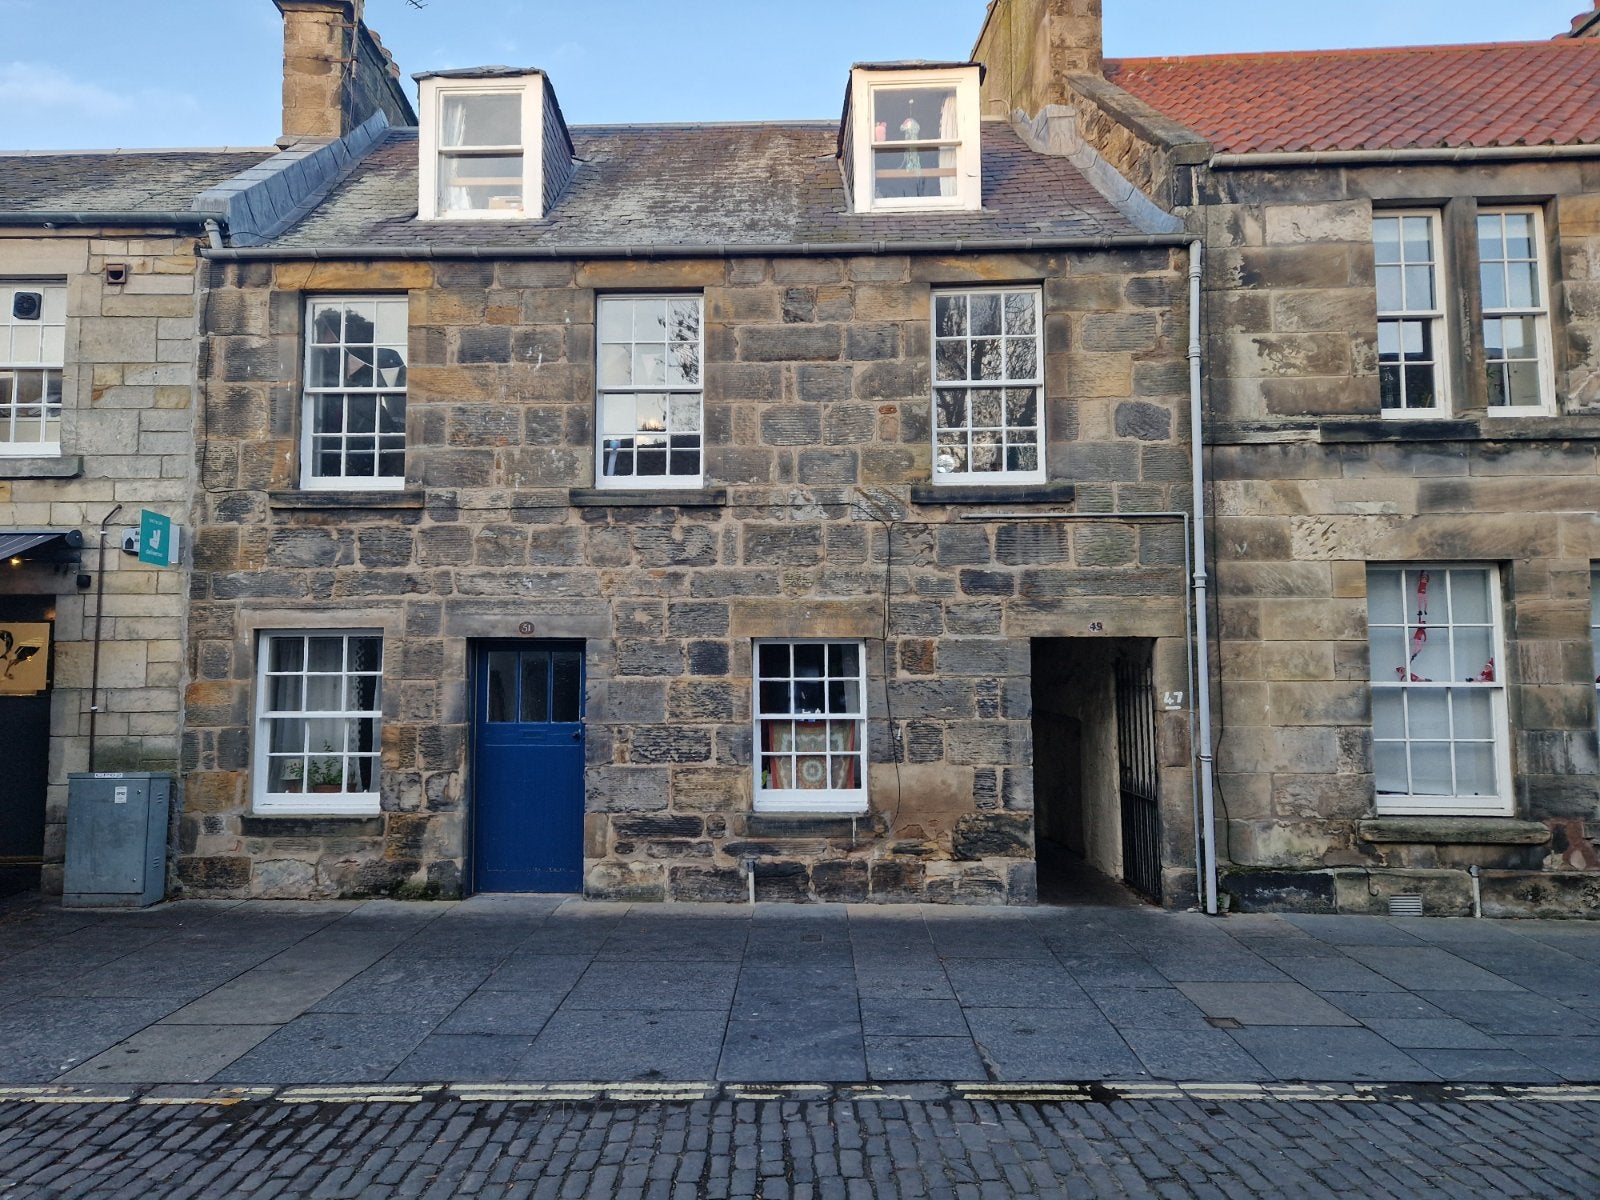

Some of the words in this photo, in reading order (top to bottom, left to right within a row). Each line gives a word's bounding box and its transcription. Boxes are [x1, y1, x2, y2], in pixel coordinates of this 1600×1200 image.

[521, 624, 531, 632] 51
[1089, 622, 1103, 631] 49
[1163, 691, 1184, 705] 47
